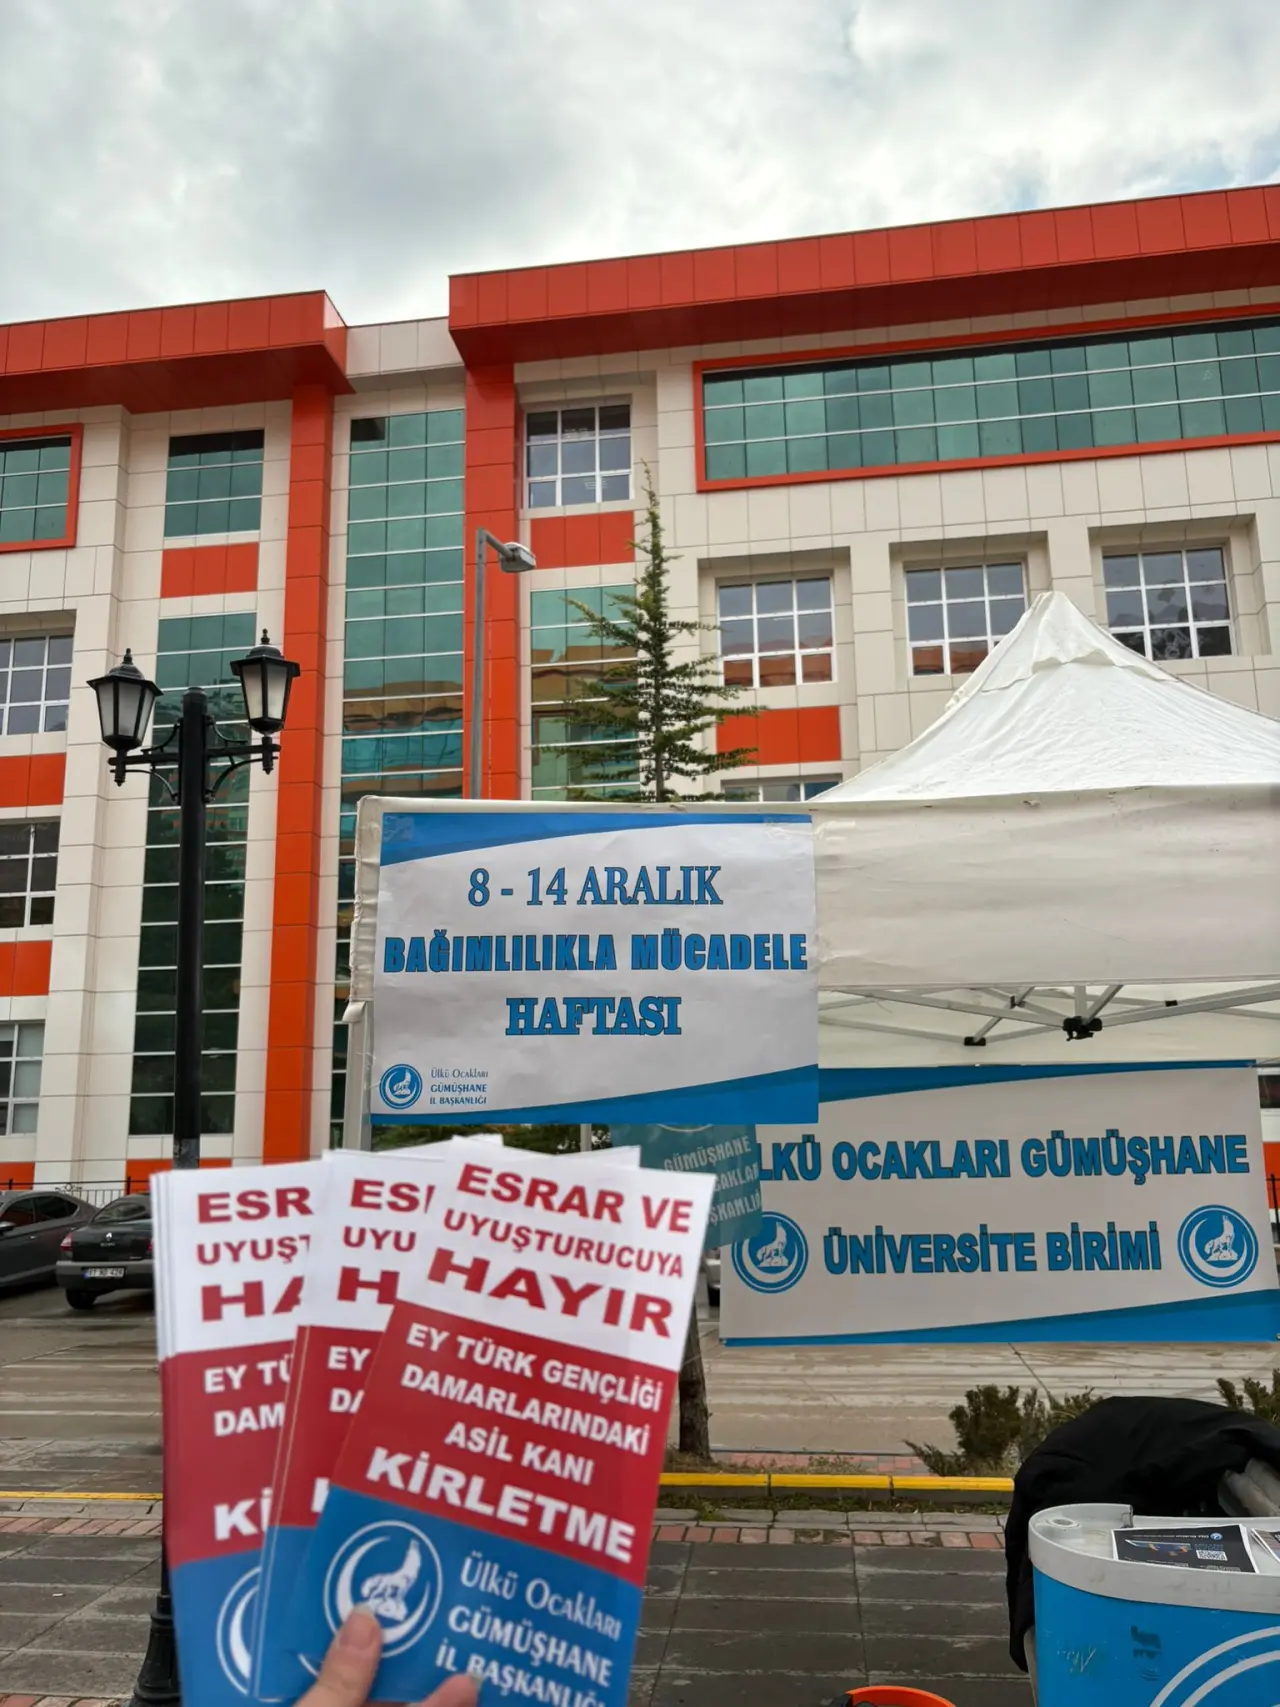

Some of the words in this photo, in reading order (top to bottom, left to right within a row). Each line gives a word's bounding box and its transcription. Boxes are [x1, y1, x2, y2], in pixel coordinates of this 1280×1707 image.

[468, 868, 490, 907] 8
[501, 887, 513, 896] -
[526, 867, 568, 906] 14
[577, 865, 723, 906] ARALIK
[383, 928, 618, 973] BAĞIMLILIKLA
[631, 928, 808, 971] MÜCADELE
[505, 996, 682, 1036] HAFTASI
[430, 1082, 488, 1095] GÜMÜŞHANE
[439, 1095, 487, 1107] BAŞKANLIĞI
[757, 1134, 822, 1181] LKÜ
[832, 1138, 1010, 1180] OCAKLARI
[1020, 1129, 1250, 1186] GÜMÜŞHANE
[197, 1186, 314, 1224] ESR
[457, 1163, 624, 1224] ESRAR
[641, 1195, 693, 1234] VE
[443, 1208, 684, 1279] UYUŞTURUCUYA
[823, 1223, 1038, 1275] ÜNİVERSİTE
[1047, 1220, 1162, 1273] BİRİMİ
[427, 1247, 674, 1339] HAYIR
[204, 1364, 247, 1394] EY
[327, 1345, 371, 1372] EY
[406, 1322, 449, 1352] EY
[456, 1333, 537, 1378] TÜRK
[541, 1359, 663, 1413] GENÇLİĞİ
[401, 1363, 651, 1456] DAMARLARINDAKİ
[445, 1421, 514, 1462] ASİL
[521, 1442, 594, 1486] KANI
[365, 1446, 636, 1564] KİRLETME
[460, 1550, 519, 1600] Ülkü
[435, 1637, 458, 1672] İL
[448, 1605, 614, 1688] GÜMÜŞHANE
